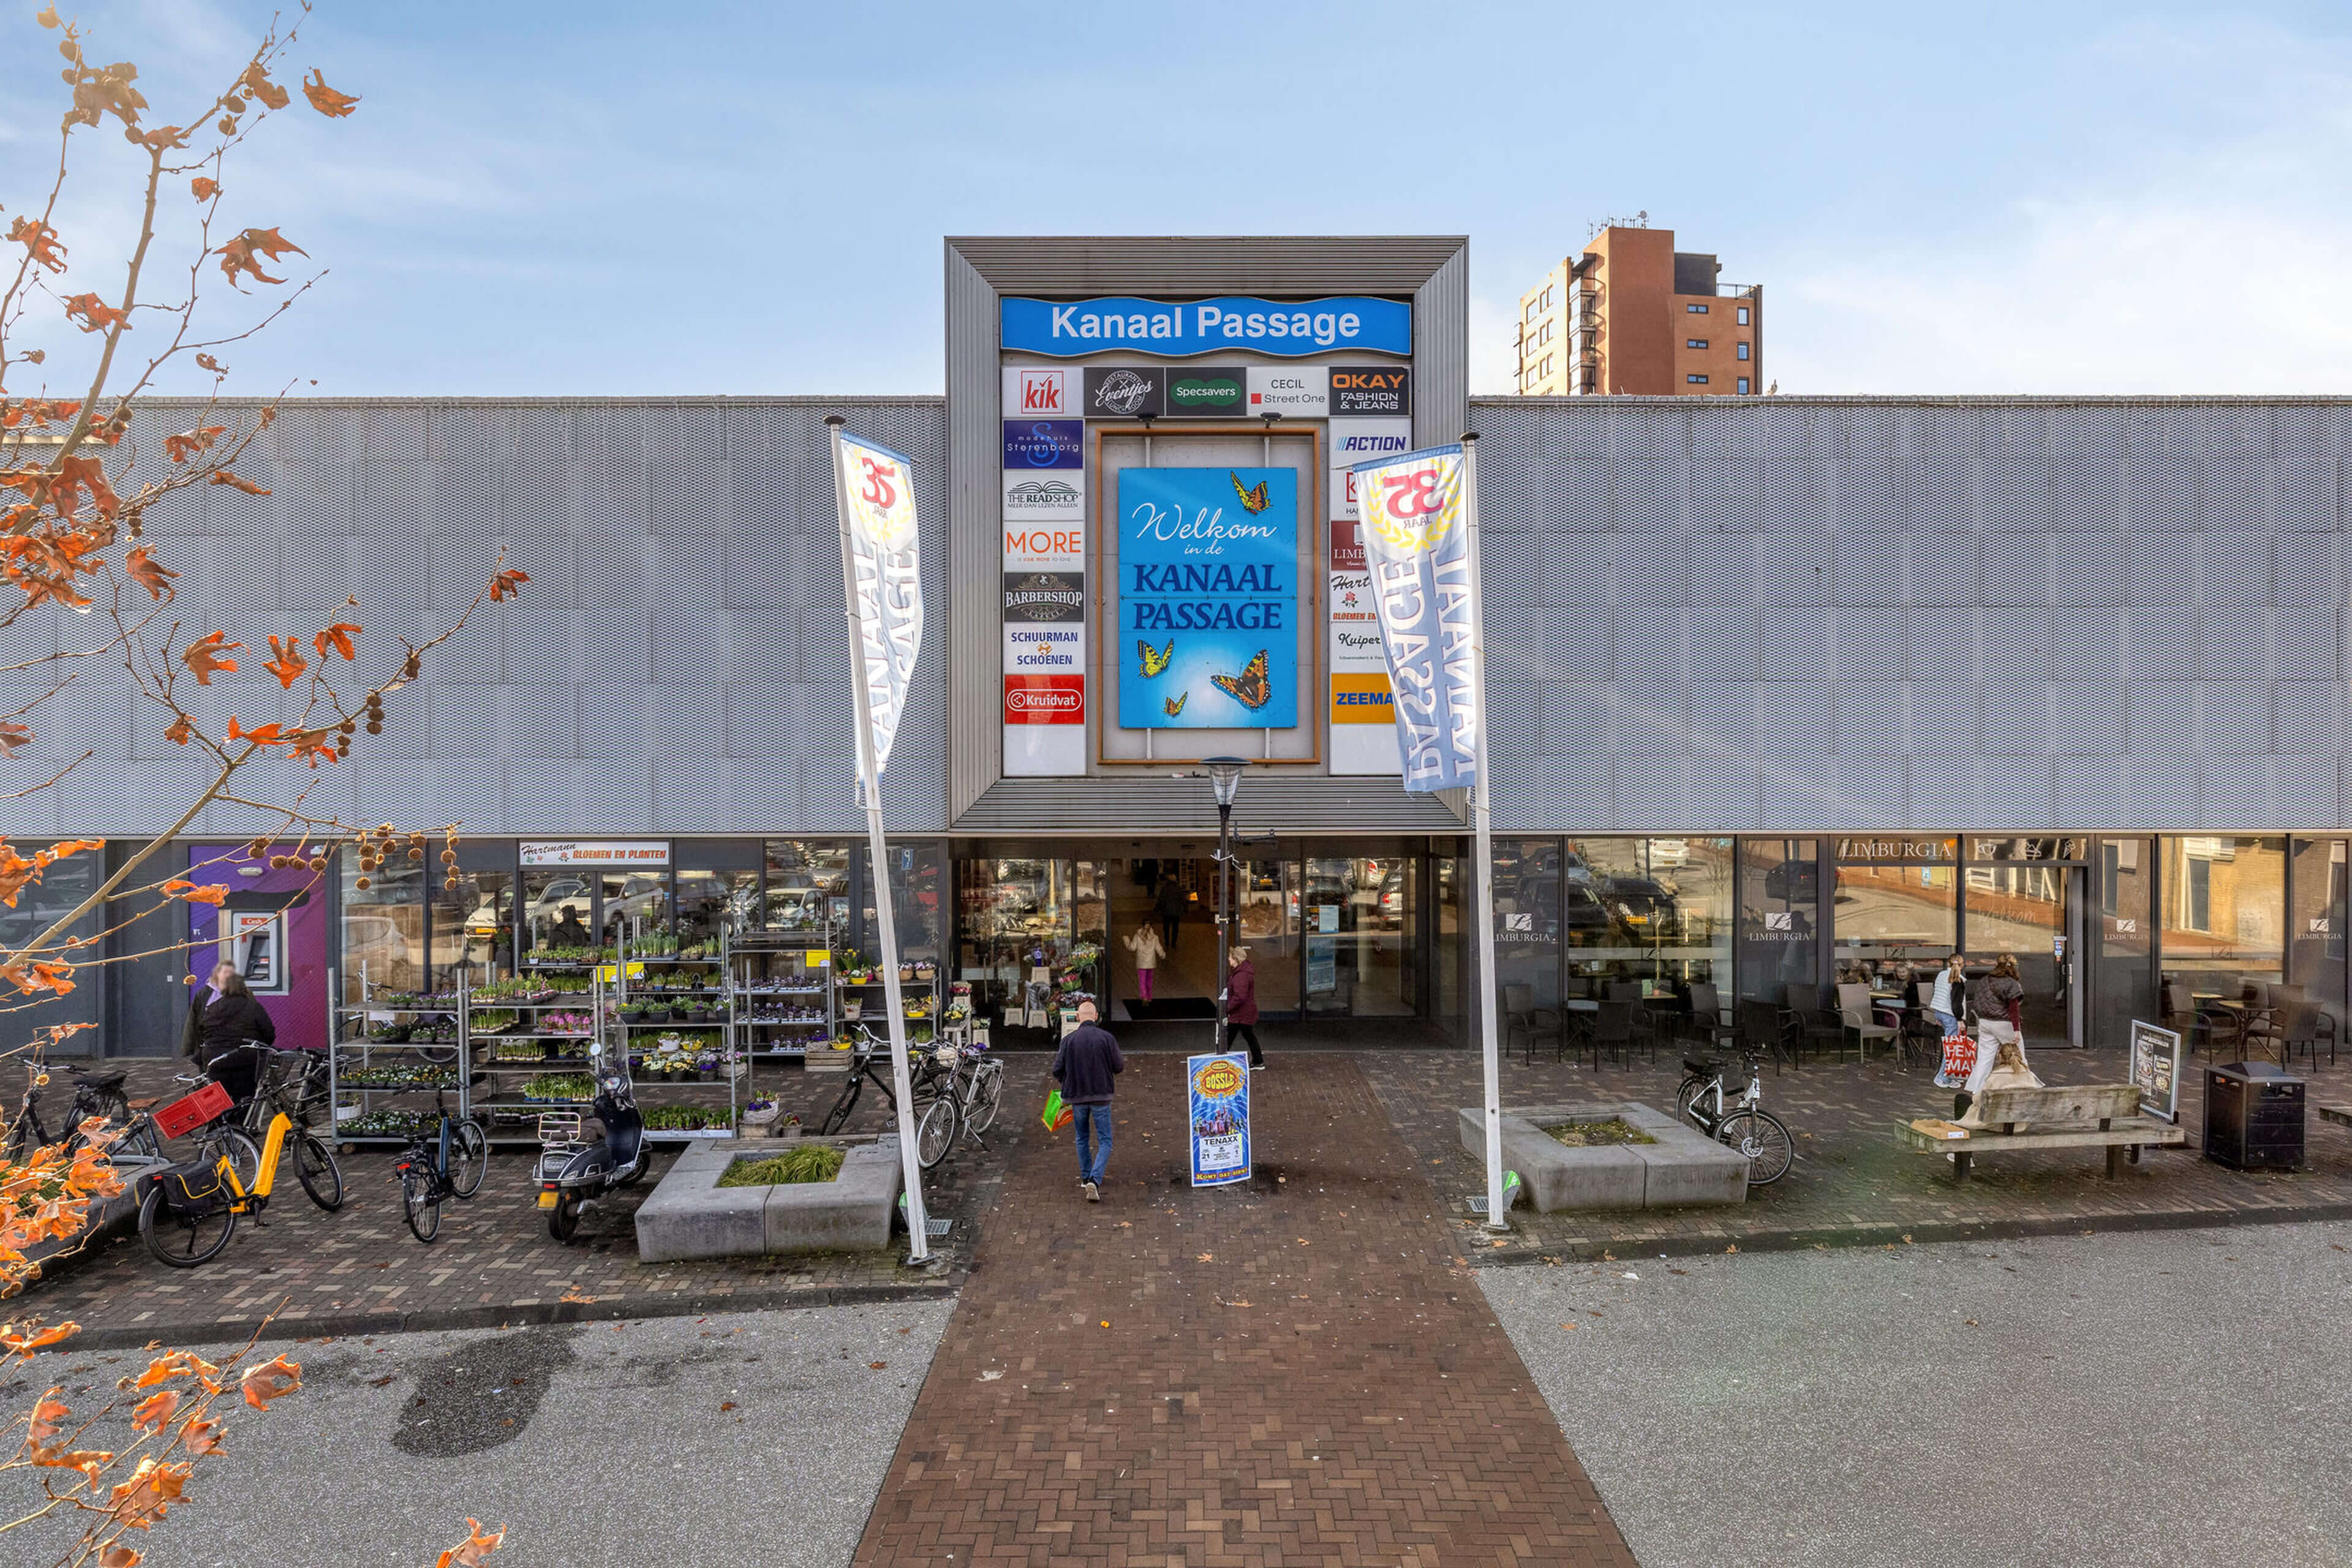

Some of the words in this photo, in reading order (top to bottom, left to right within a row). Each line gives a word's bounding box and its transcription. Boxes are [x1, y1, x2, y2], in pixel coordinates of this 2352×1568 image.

[1052, 306, 1183, 339] Kanaal
[1197, 306, 1361, 345] Passage
[1271, 380, 1305, 389] CECIL
[1332, 374, 1405, 388] OKAY
[1176, 386, 1235, 399] Specsavers
[1264, 394, 1300, 403] Street
[1302, 394, 1325, 403] One
[1355, 401, 1399, 410] JEANS
[1008, 443, 1078, 452] Sterenborg
[1345, 436, 1406, 451] ACTION
[862, 457, 896, 509] 35
[1008, 494, 1025, 503] THE
[1027, 494, 1052, 503] READ
[1053, 494, 1079, 503] SHOP
[1133, 503, 1277, 541] Welkom
[1006, 532, 1081, 554] MORE
[1185, 543, 1202, 555] in
[1204, 540, 1224, 555] de
[1133, 565, 1282, 592] KANAAL
[1005, 591, 1082, 607] BARBERSHOP
[1133, 603, 1281, 630] PASSAGE
[1011, 632, 1078, 642] SCHUURMAN
[1338, 633, 1381, 649] Kuiper
[1017, 655, 1072, 665] SCHOENEN
[1027, 695, 1076, 706] Kruidvat
[1336, 693, 1393, 705] ZEEMA
[521, 843, 576, 856] Hartmann
[1841, 843, 1952, 856] LIMBURGIA
[1204, 1136, 1238, 1145] TENAXX
